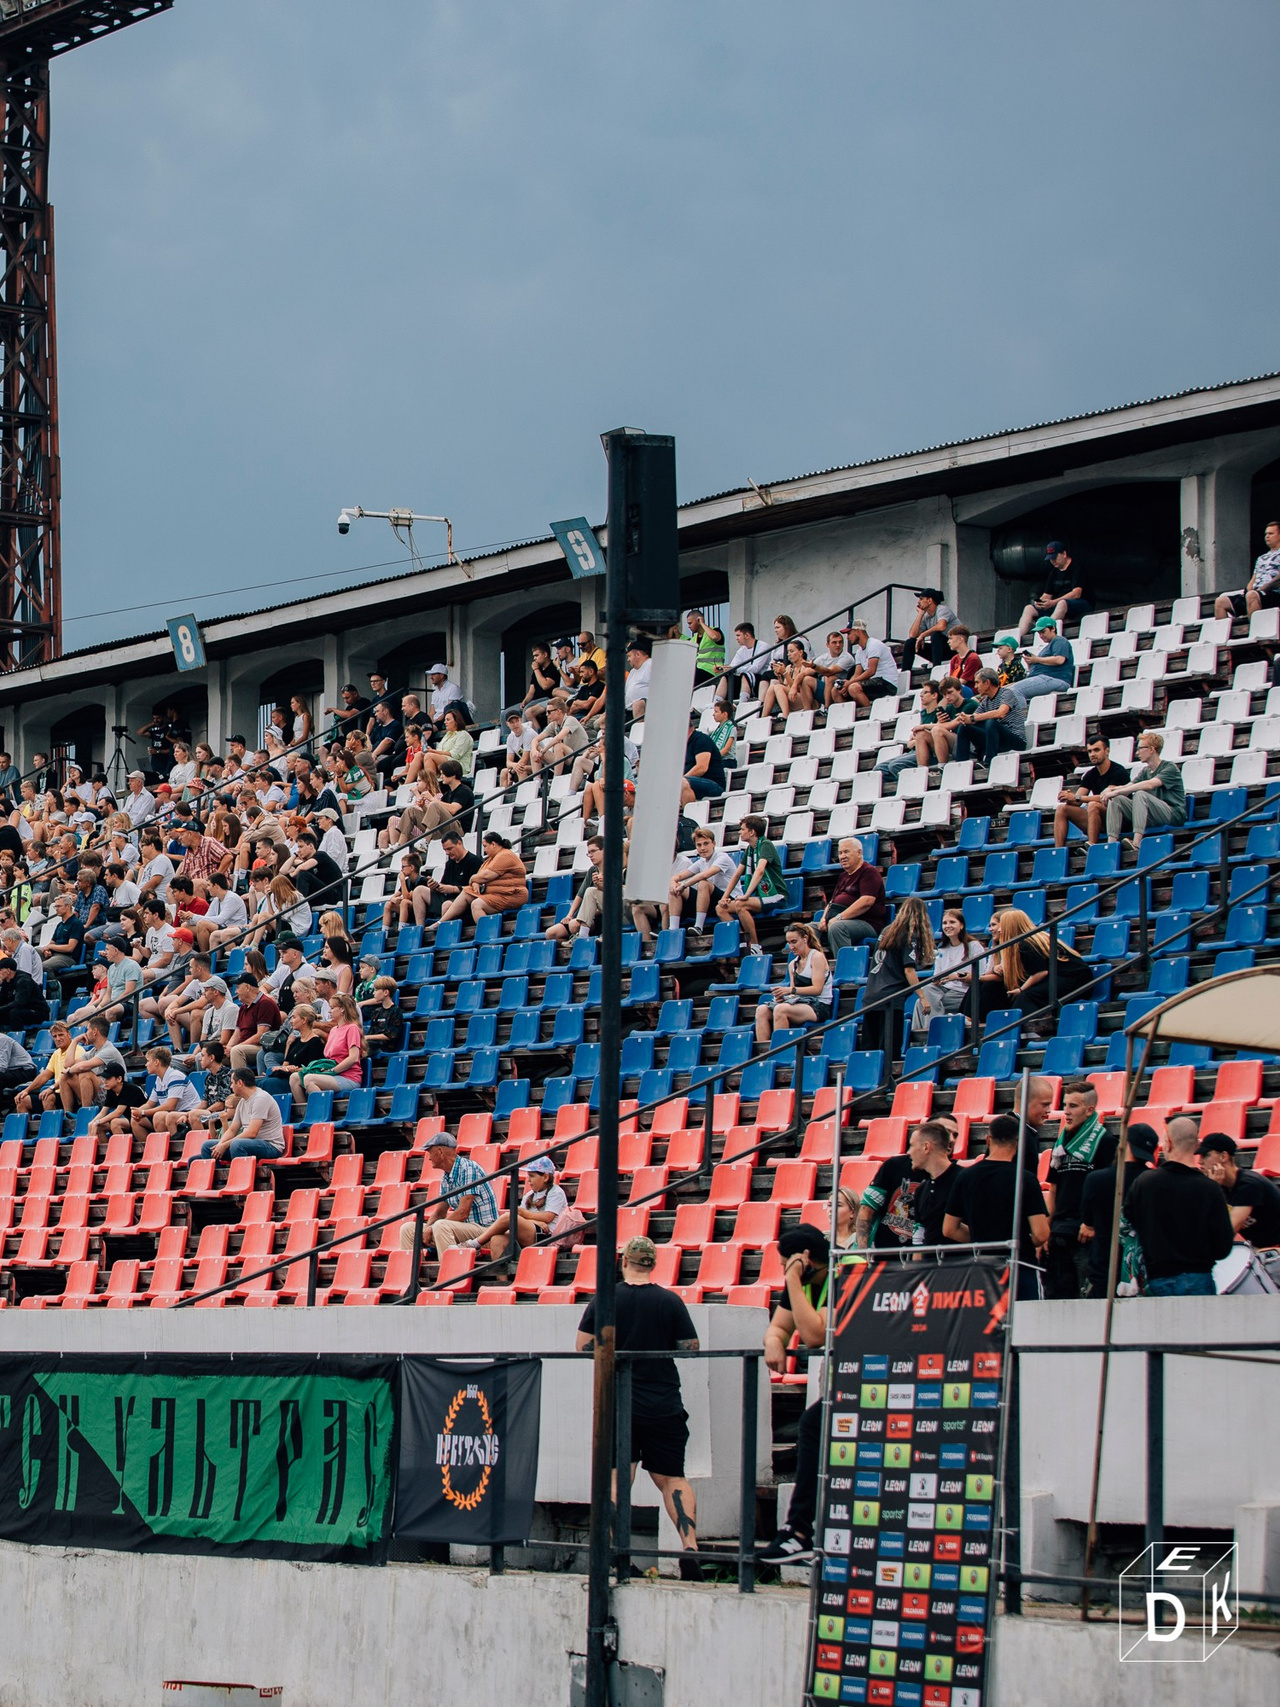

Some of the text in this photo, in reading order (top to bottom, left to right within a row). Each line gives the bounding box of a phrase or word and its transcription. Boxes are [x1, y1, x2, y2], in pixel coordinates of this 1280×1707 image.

[567, 530, 596, 571] 9
[177, 625, 195, 663] 8
[872, 1291, 910, 1313] LEON
[931, 1289, 986, 1309] ЛИГА Б
[838, 1362, 859, 1374] LEON
[892, 1362, 914, 1374] LEON
[947, 1360, 969, 1372] LEON
[861, 1420, 883, 1432] LEON
[916, 1420, 938, 1432] LEON
[972, 1420, 995, 1433] LEON
[831, 1478, 852, 1490] LEON
[885, 1480, 906, 1492] LEON
[940, 1481, 962, 1493] LEON
[854, 1537, 875, 1549] LEON
[908, 1541, 930, 1552] LEON
[965, 1543, 988, 1555] LEON
[823, 1593, 844, 1605] LEON
[876, 1598, 898, 1610] LEON
[932, 1602, 954, 1614] LEON
[845, 1654, 866, 1666] LEON
[900, 1660, 921, 1672] LEON
[956, 1665, 978, 1677] LEON
